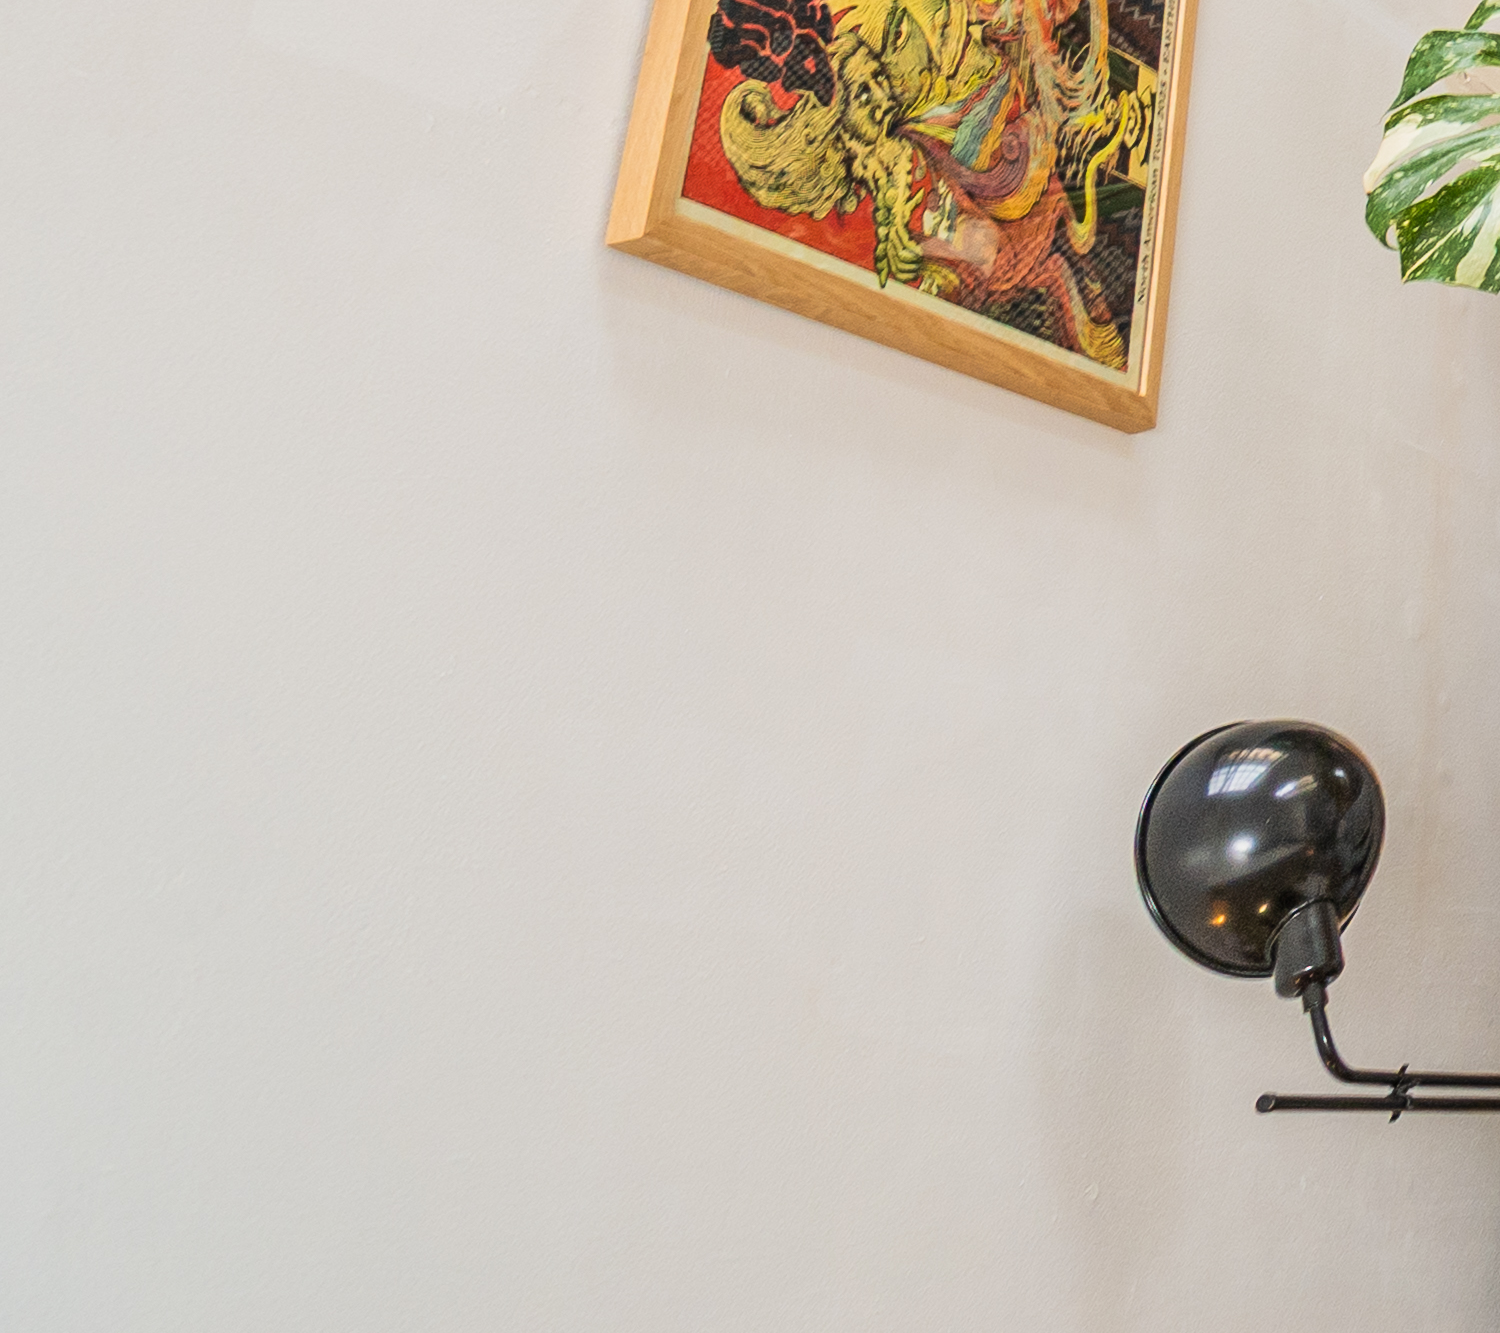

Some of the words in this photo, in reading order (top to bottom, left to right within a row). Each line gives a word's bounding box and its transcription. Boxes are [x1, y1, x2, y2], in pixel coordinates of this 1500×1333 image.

[1137, 254, 1149, 305] North
[1143, 168, 1158, 246] American
[1152, 121, 1163, 161] Tour
